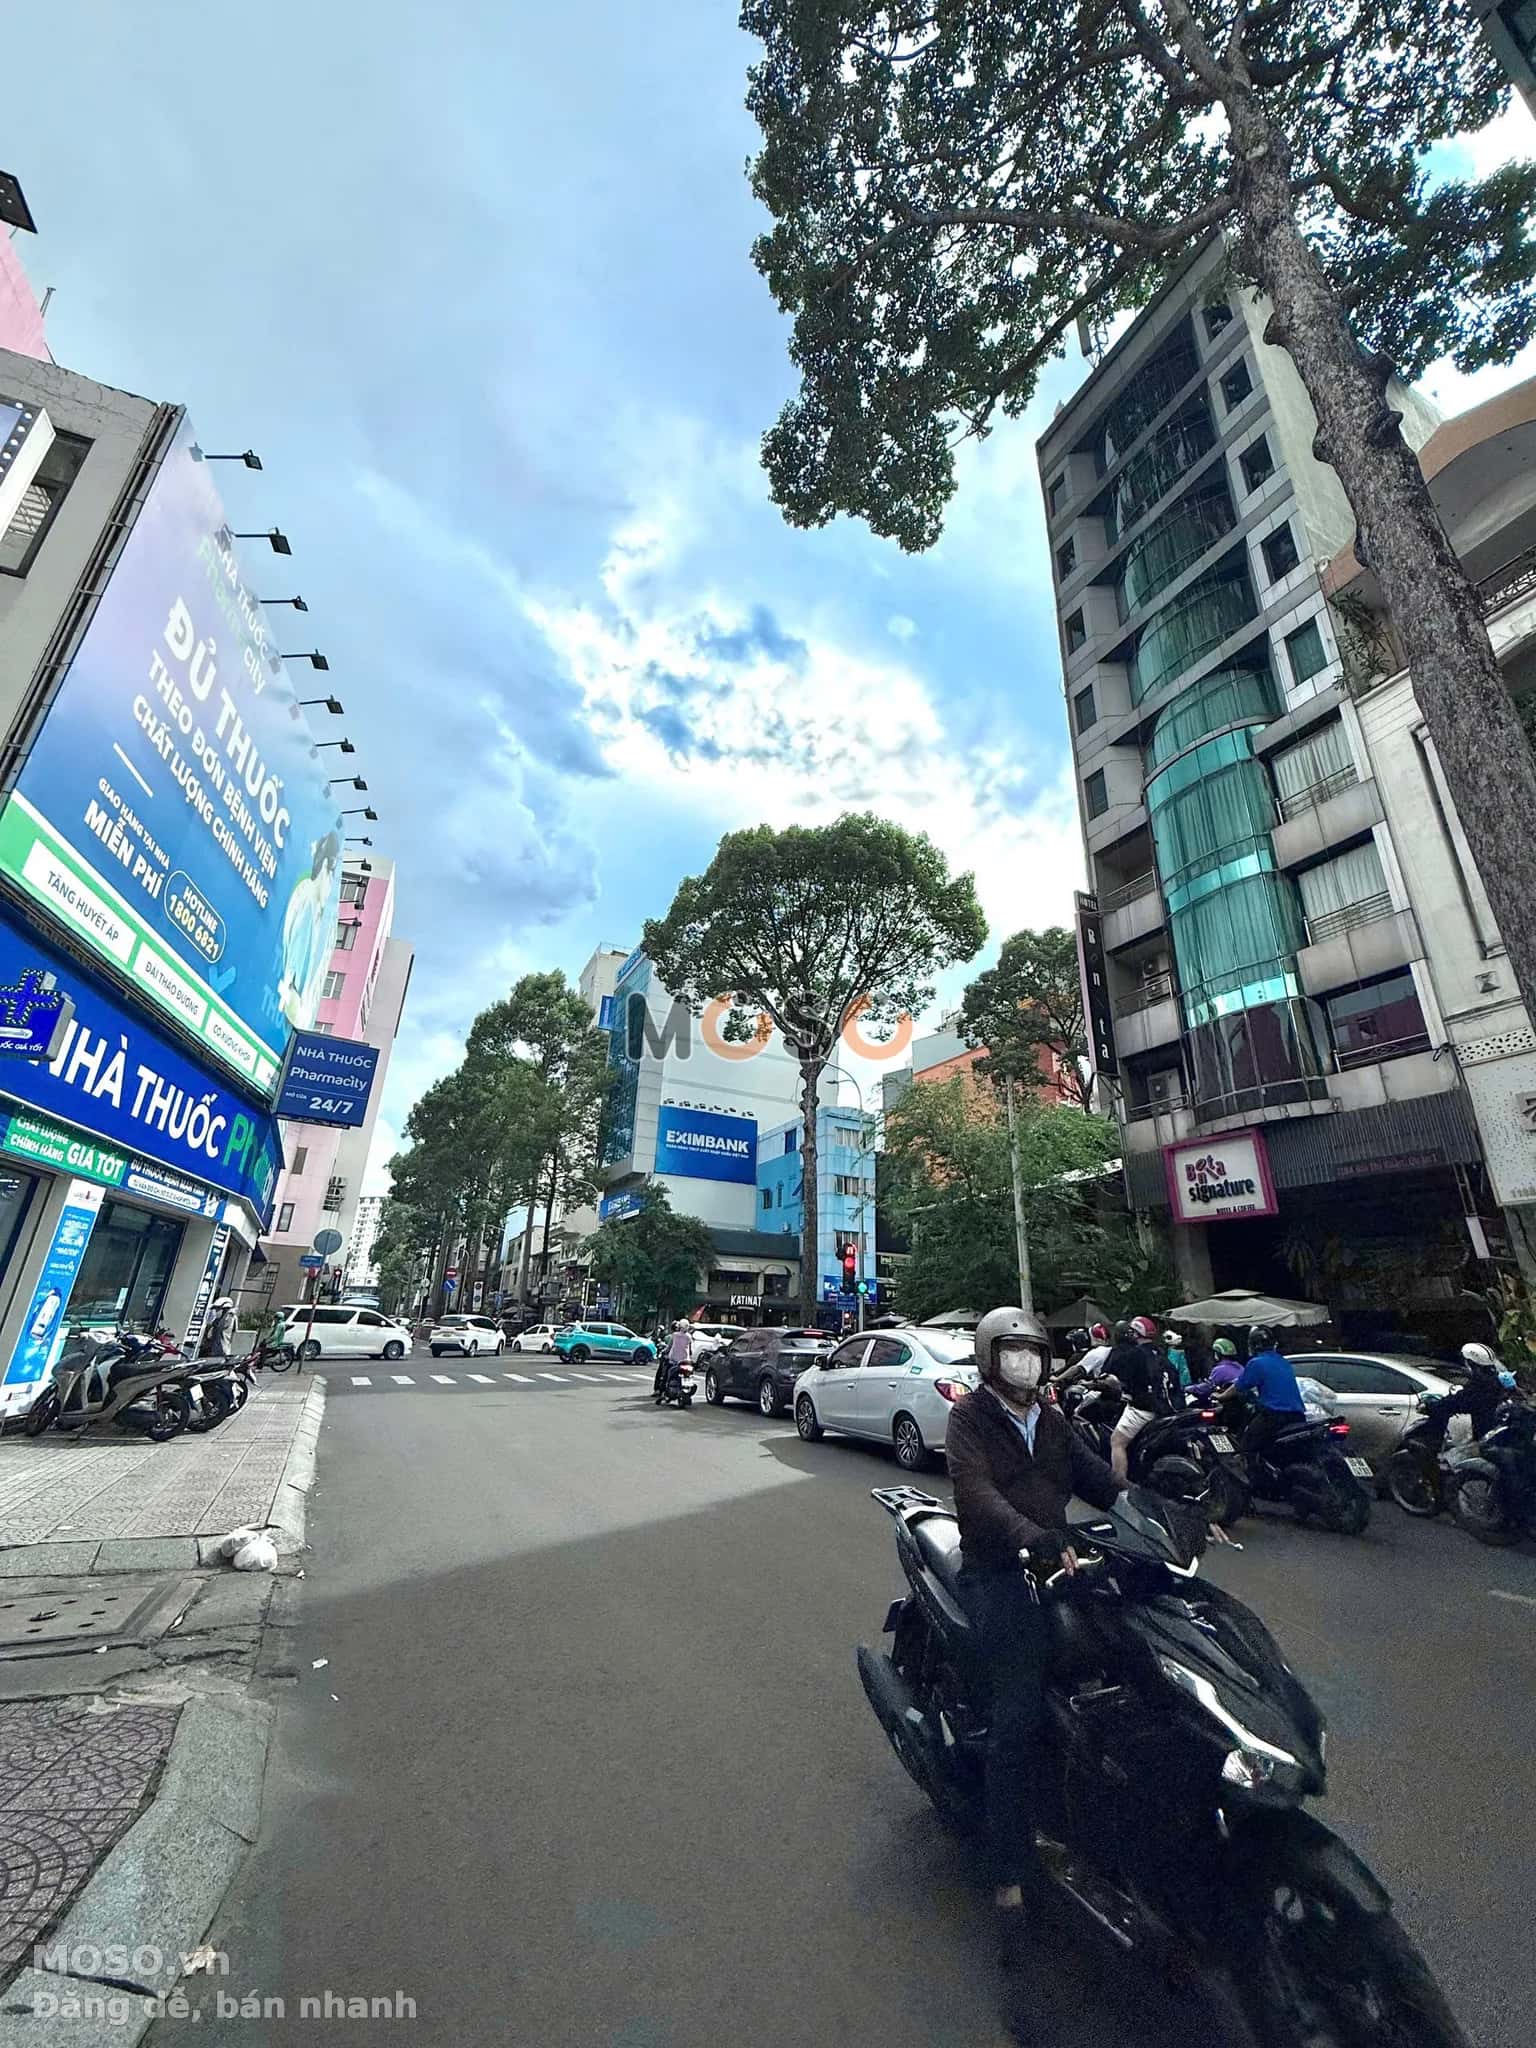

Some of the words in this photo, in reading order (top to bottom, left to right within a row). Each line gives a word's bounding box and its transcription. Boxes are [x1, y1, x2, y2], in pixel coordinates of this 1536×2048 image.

[163, 595, 217, 701] ĐỦ
[215, 687, 291, 849] THUỐC
[149, 648, 193, 735] THEO
[191, 727, 225, 791] ĐƠN
[222, 779, 257, 843] BỆNH
[254, 828, 278, 880] VIỆN
[98, 777, 122, 809] GIAO
[120, 802, 144, 838] HÀNG
[133, 694, 175, 761] CHẤT
[169, 752, 215, 825] LƯỢNG
[212, 816, 246, 872] CHÍNH
[242, 861, 269, 909] HÀNG
[84, 797, 136, 868] MIỄN
[131, 853, 165, 899] PHÍ
[47, 870, 76, 905] TĂNG
[76, 896, 107, 932] HUYẾT
[106, 923, 119, 942] ÁP
[169, 894, 196, 933] 1800
[194, 925, 219, 960] 6821
[182, 885, 219, 935] HOTLINE
[289, 1066, 368, 1092] Pharmacity
[296, 1046, 326, 1061] NHÀ
[328, 1052, 372, 1069] THUỐC
[130, 1063, 227, 1159] THUỐC
[309, 1096, 354, 1114] 24/7
[10, 1132, 41, 1154] CHÍNH
[39, 1142, 65, 1161] HÀNG
[66, 1142, 96, 1171] GIÁ
[95, 1151, 125, 1180] TỐT
[665, 1129, 750, 1154] EXIMBANK
[1188, 1178, 1256, 1204] signature
[730, 1295, 763, 1308] KATINAT
